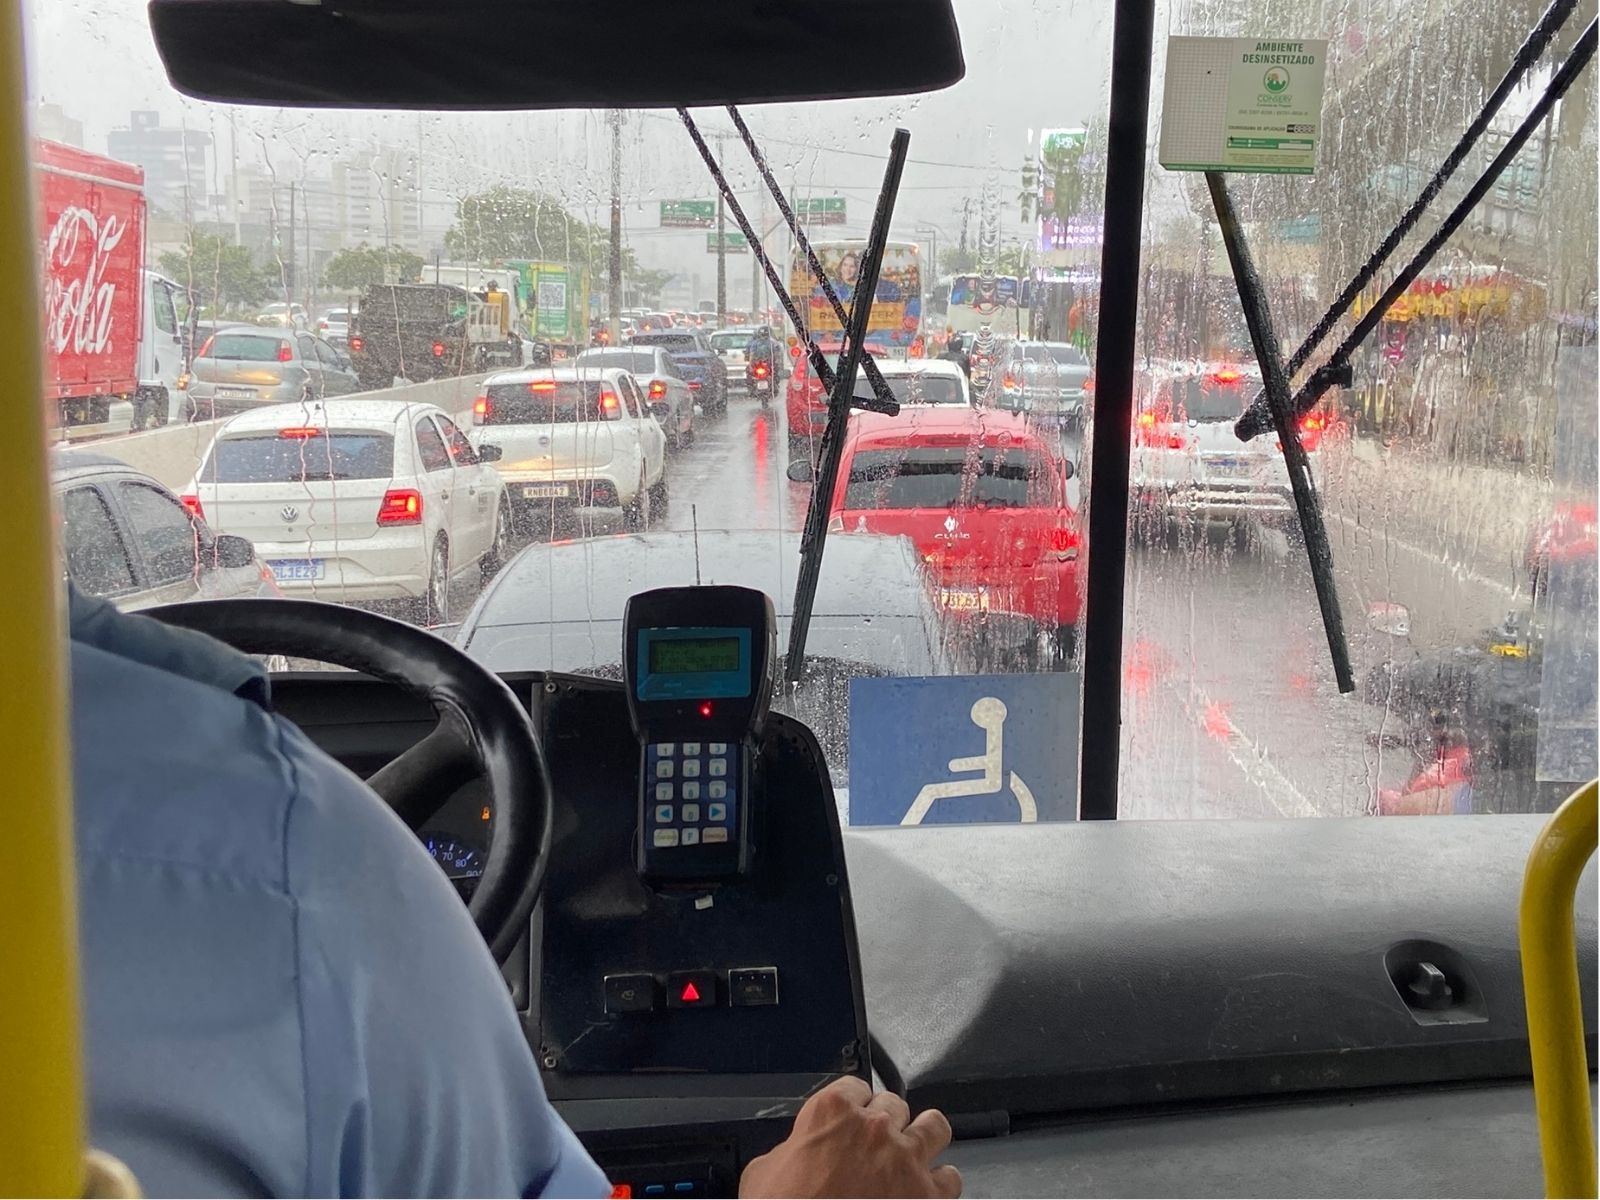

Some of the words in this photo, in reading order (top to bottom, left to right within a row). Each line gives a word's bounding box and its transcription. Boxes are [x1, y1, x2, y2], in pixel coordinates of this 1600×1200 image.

[1256, 42, 1303, 53] AMBIENTE
[1242, 54, 1315, 65] DESINSETIZADO
[442, 851, 454, 861] 70
[455, 859, 467, 868] 80
